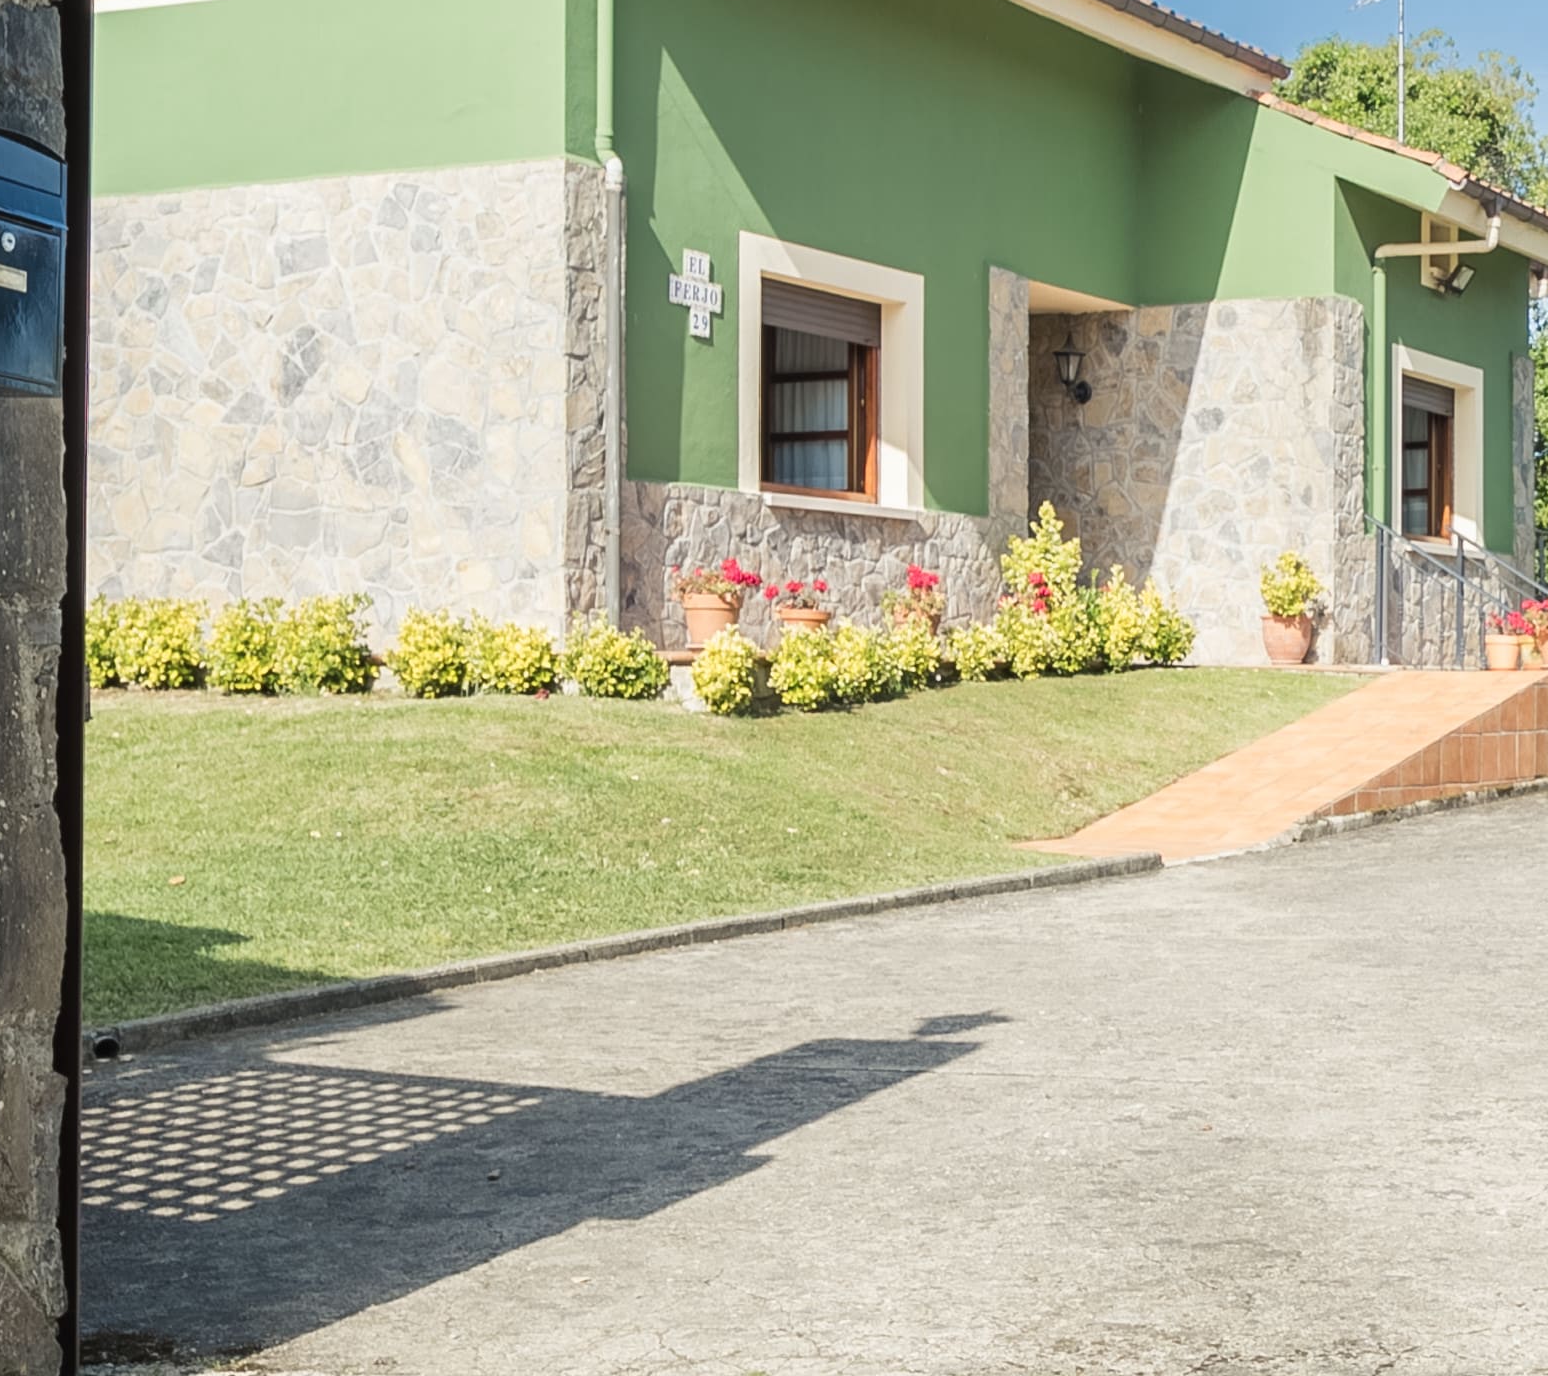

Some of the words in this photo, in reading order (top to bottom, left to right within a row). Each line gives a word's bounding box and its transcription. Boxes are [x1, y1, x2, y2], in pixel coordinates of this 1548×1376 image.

[689, 256, 706, 275] EL
[674, 280, 718, 306] PERJO
[693, 314, 708, 330] 29
